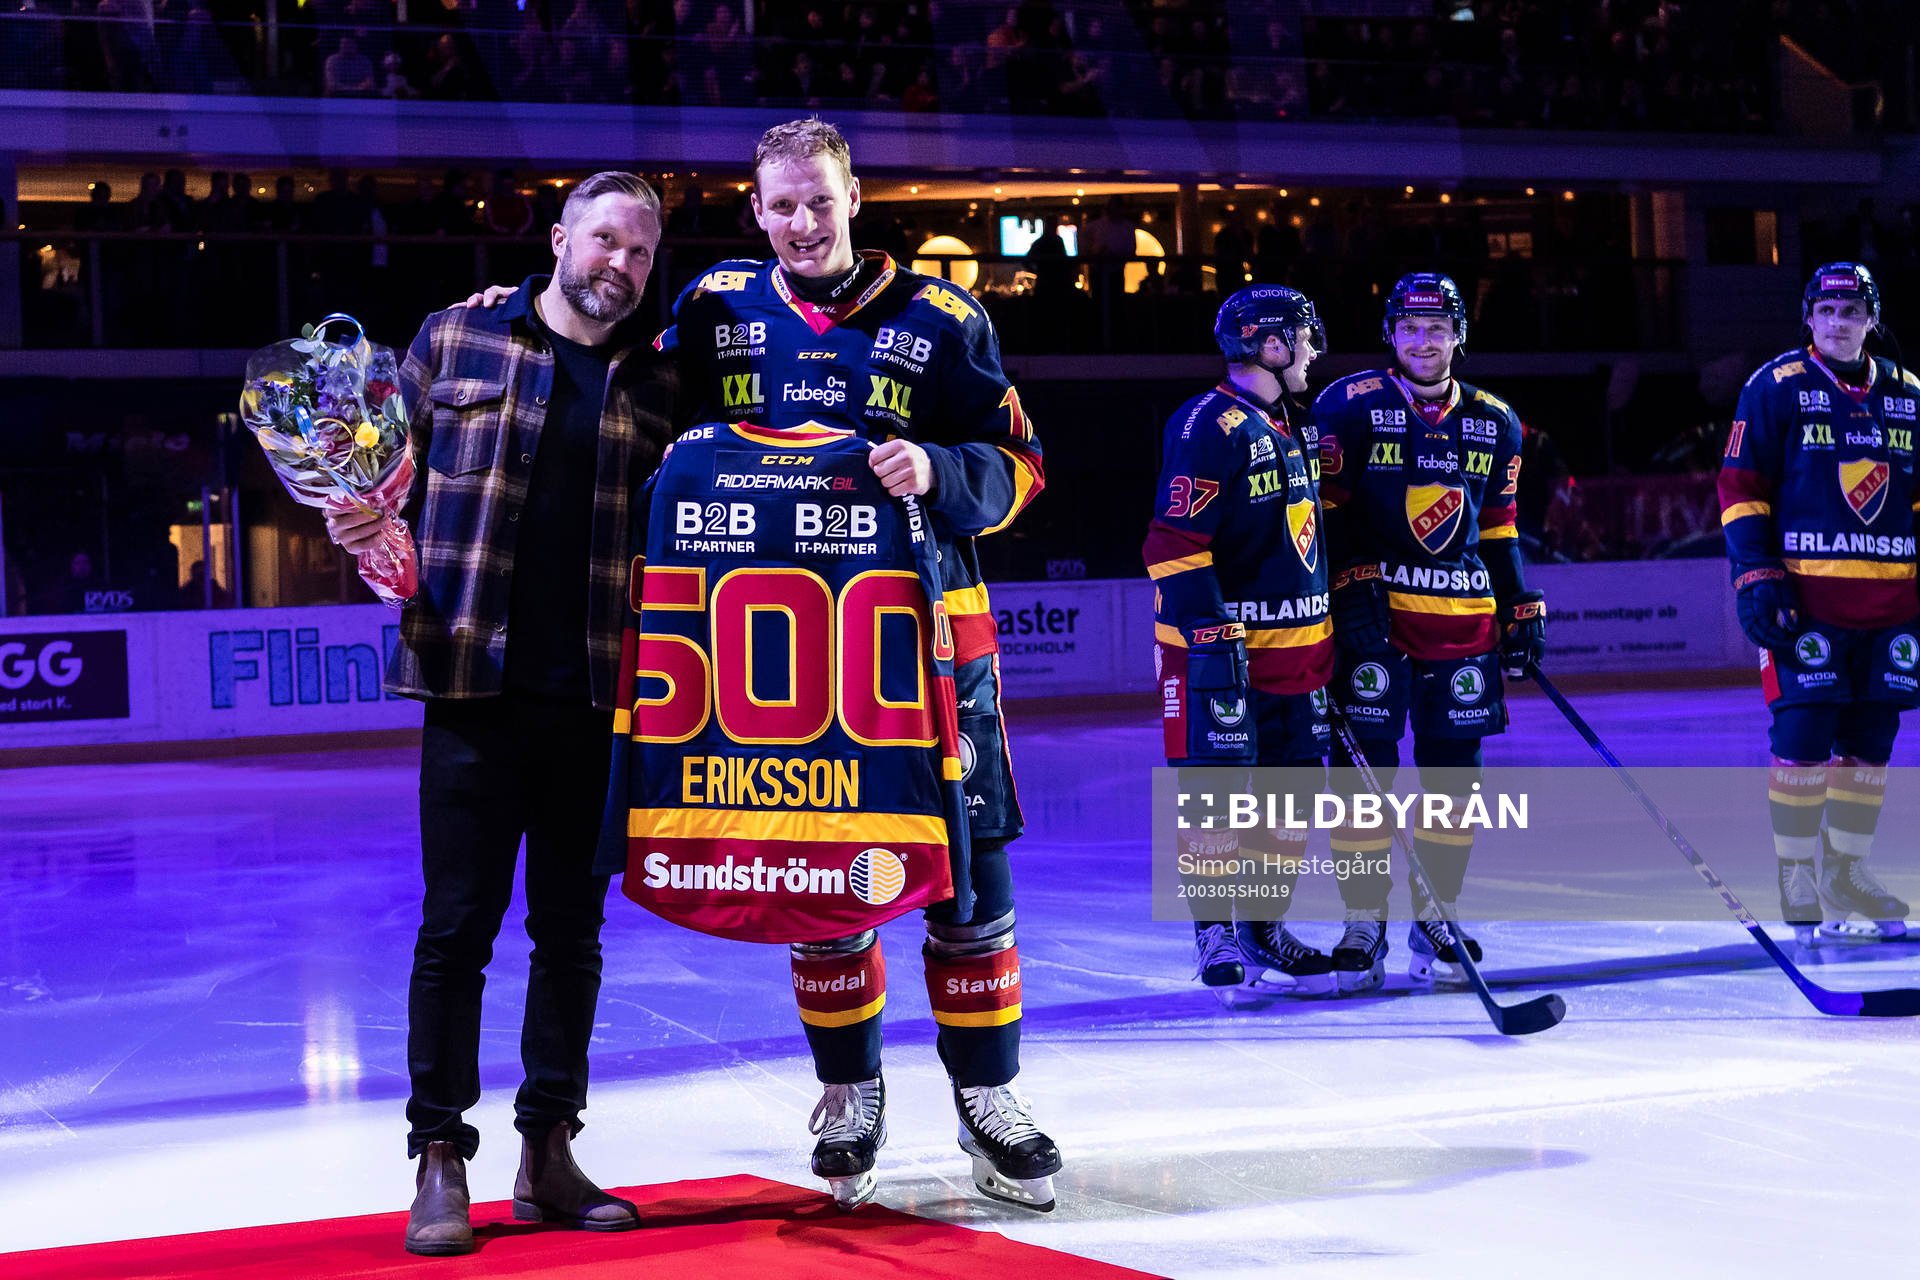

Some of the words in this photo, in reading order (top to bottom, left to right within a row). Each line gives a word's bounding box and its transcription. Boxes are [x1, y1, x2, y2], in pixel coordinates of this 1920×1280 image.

[692, 271, 757, 301] ABT
[912, 284, 978, 323] ABT
[715, 322, 767, 348] B2B
[874, 327, 933, 363] B2B
[717, 347, 766, 359] IT-PARTNER
[797, 352, 838, 360] CCM
[870, 350, 924, 374] IT-PARTNER
[723, 373, 765, 408] XXL
[783, 380, 846, 407] Fabege
[866, 375, 912, 418] XXL
[1799, 389, 1831, 406] B2B
[1370, 409, 1407, 425] B2B
[1883, 396, 1916, 414] B2B
[1462, 417, 1498, 436] B2B
[1802, 423, 1836, 445] XXL
[1250, 435, 1274, 460] B2B
[1887, 428, 1914, 452] XXL
[760, 455, 815, 466] CCM
[1369, 443, 1404, 465] XXL
[1417, 454, 1458, 474] Fabege
[715, 474, 832, 491] RIDDERMARK
[832, 477, 858, 491] BIL
[1248, 470, 1281, 497] XXL
[1165, 475, 1220, 518] 37
[676, 502, 757, 536] B2B
[795, 503, 878, 538] B2B
[903, 493, 926, 543] MIDE
[675, 539, 756, 554] IT-PARTNER
[795, 542, 878, 556] IT-PARTNER
[998, 601, 1079, 635] aster
[1193, 622, 1247, 644] CC
[632, 566, 940, 748] 500
[1163, 677, 1180, 718] telli
[1345, 704, 1391, 717] ŠKODA
[1448, 706, 1490, 720] ŠKODA
[1207, 731, 1249, 742] ŠKODA
[682, 756, 859, 808] ERIKSSON
[643, 852, 846, 895] Sundström
[792, 970, 865, 993] Stavdal
[946, 966, 1020, 994] Stavdal
